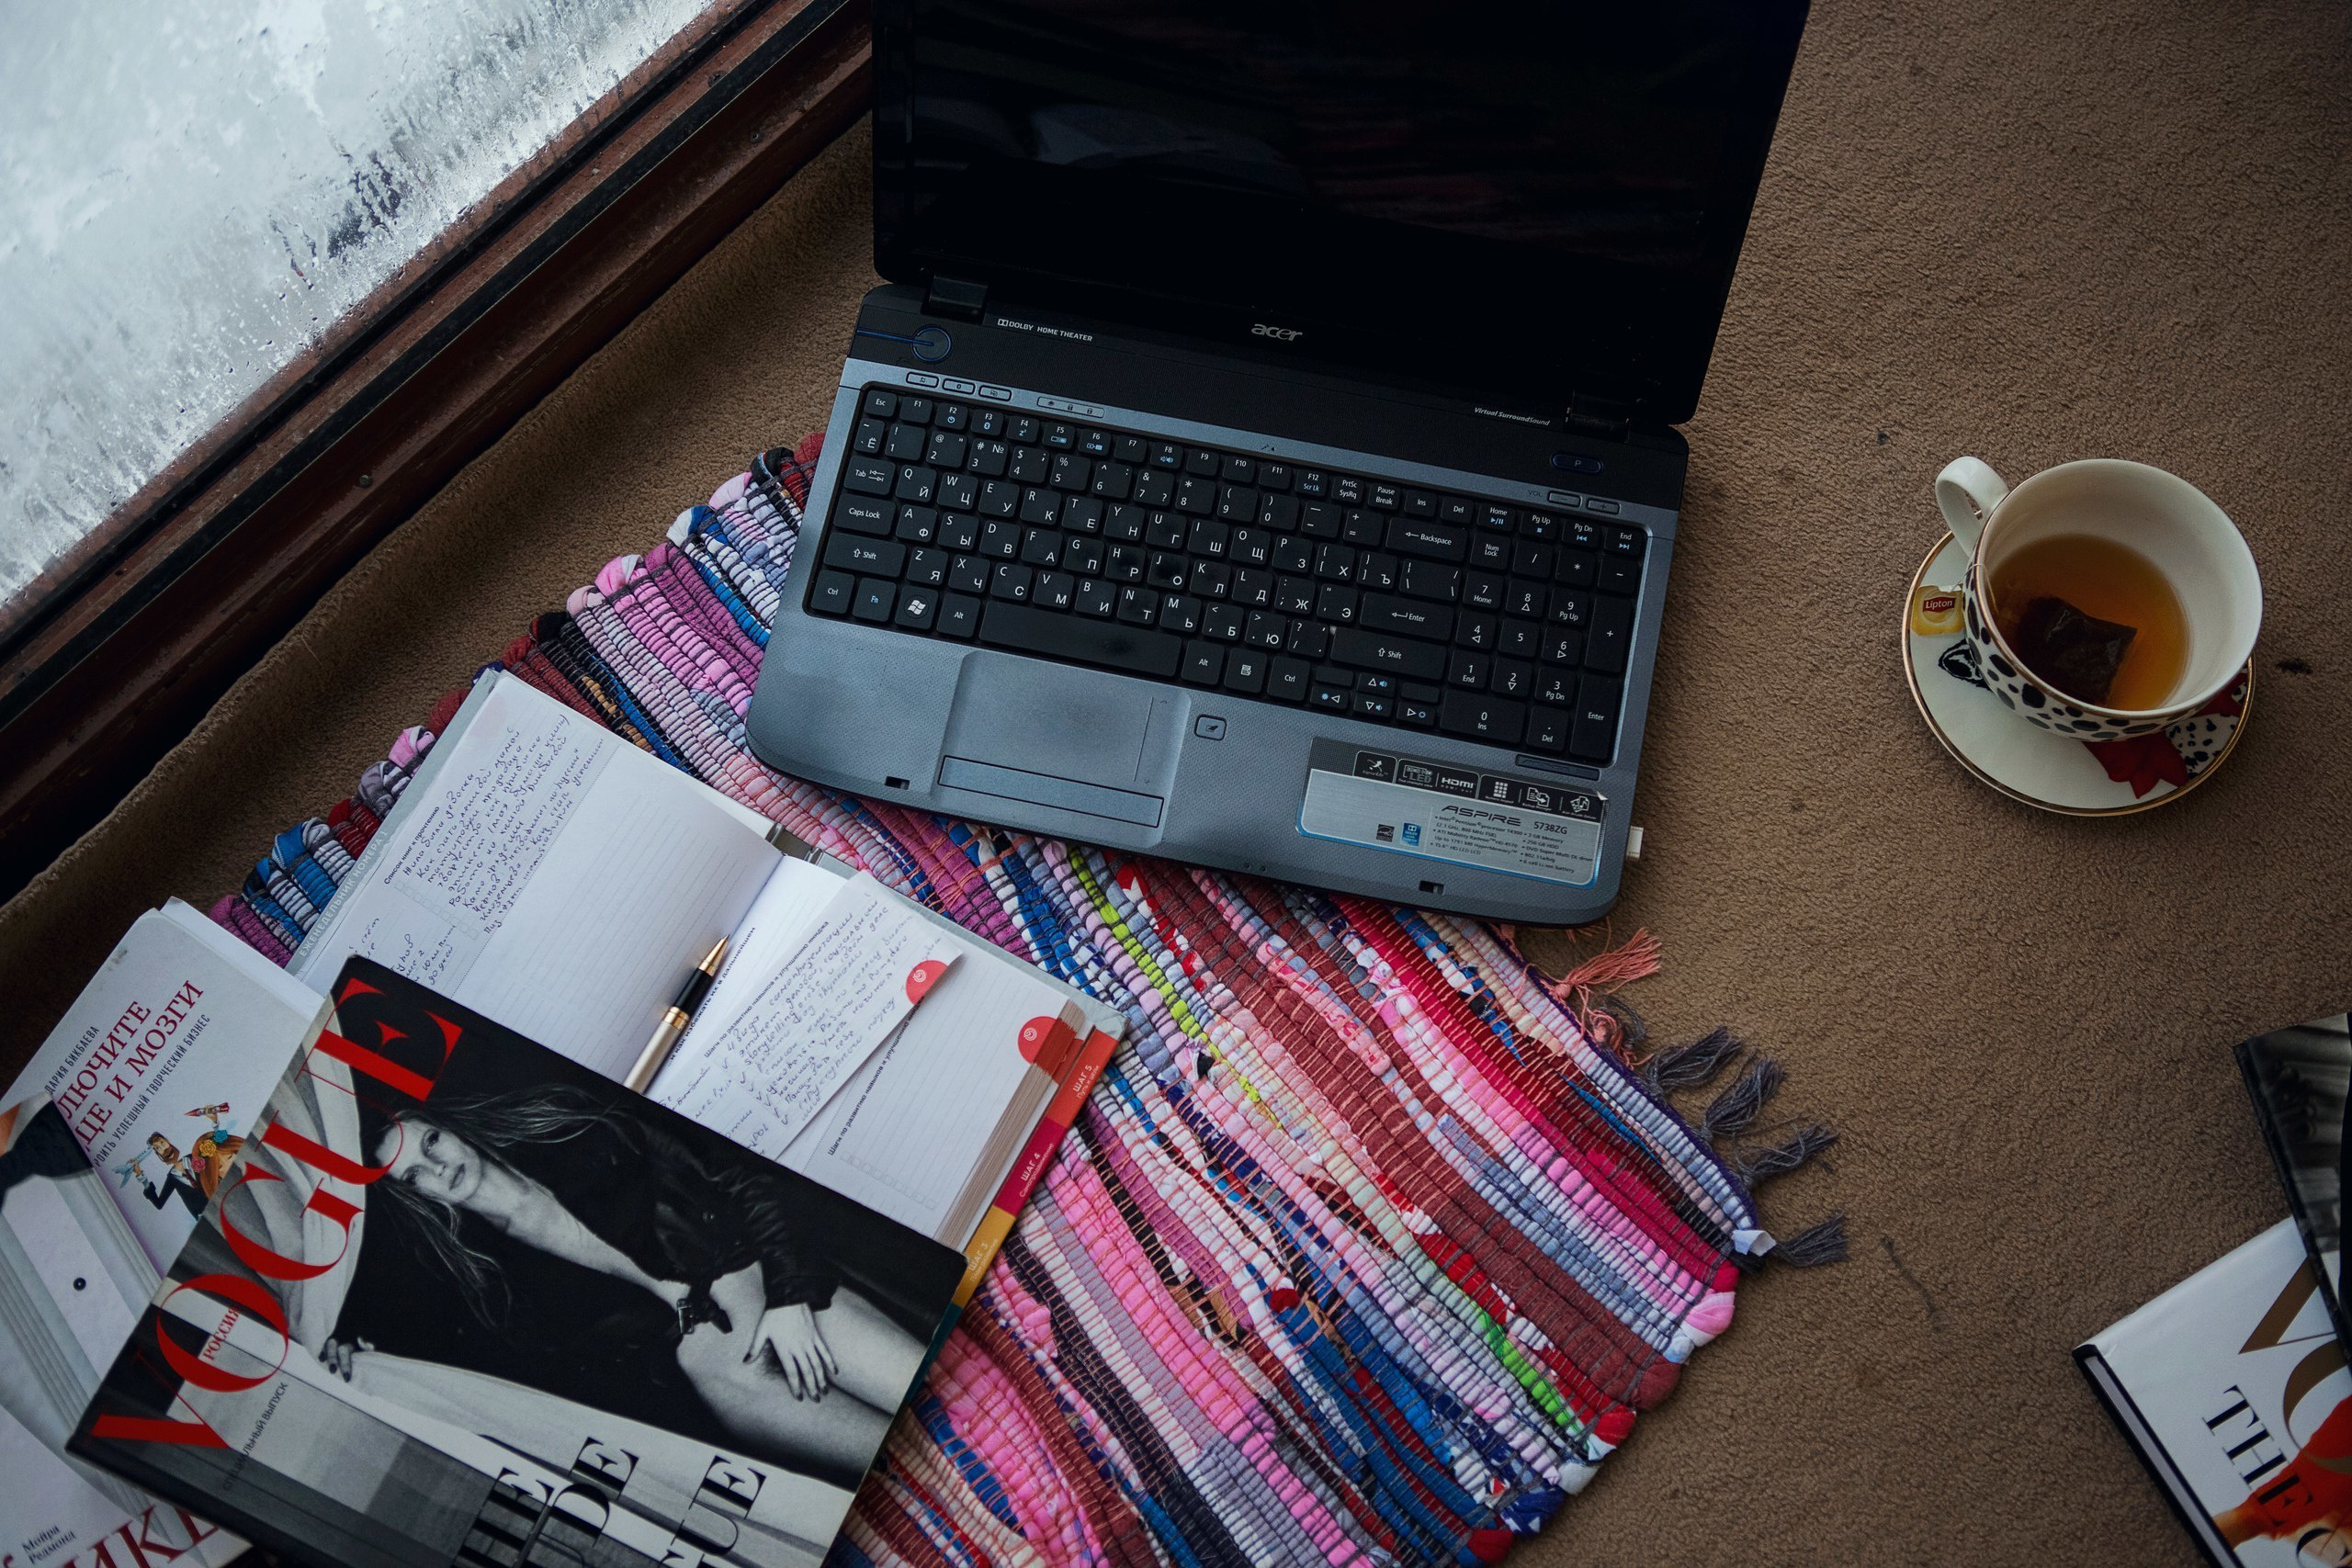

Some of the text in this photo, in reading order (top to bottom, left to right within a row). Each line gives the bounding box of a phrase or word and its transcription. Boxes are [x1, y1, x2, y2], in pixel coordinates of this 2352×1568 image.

[1009, 321, 1092, 342] DOLBY HOME THEATER
[1251, 323, 1303, 341] acer
[876, 398, 886, 406] Esc
[1475, 407, 1550, 425] Virtual SurroundSound
[890, 444, 895, 452] 1
[931, 451, 937, 459] 2
[972, 458, 978, 467] 3
[904, 468, 912, 479] Q
[1013, 467, 1020, 475] 4
[1272, 466, 1283, 474] F11
[1055, 473, 1061, 482] 5
[1307, 473, 1319, 481] F12
[1097, 481, 1102, 490] 6
[1342, 479, 1357, 488] PrtSc
[1139, 489, 1146, 498] 7
[1340, 490, 1357, 500] SysRq
[1376, 486, 1395, 497] Pause
[1181, 497, 1187, 505] 8
[1375, 496, 1393, 505] Break
[849, 507, 880, 519] Caps Lock
[1223, 504, 1229, 513] 9
[1489, 507, 1508, 515] Home
[1532, 514, 1551, 525] Pg Up
[1574, 523, 1583, 532] Pg
[1420, 534, 1452, 545] Backspace
[1620, 532, 1632, 540] End
[863, 551, 876, 559] Shift
[871, 595, 878, 604] Fn
[1474, 595, 1492, 604] Home
[1925, 599, 1953, 610] Lipton
[1408, 613, 1425, 622] Enter
[1559, 611, 1578, 621] Pg Up
[1387, 650, 1402, 660] Shift
[1284, 674, 1295, 682] Ctrl
[1463, 674, 1475, 682] End
[1545, 691, 1555, 700] Pg
[1588, 712, 1604, 720] Enter
[1542, 734, 1554, 742] Del
[1442, 777, 1474, 788] HDMI
[1441, 805, 1521, 827] ASPIRE
[1533, 821, 1567, 835] 5738ZG
[384, 861, 403, 885] Список
[401, 846, 413, 861] книг
[414, 807, 439, 840] прочтению
[300, 878, 356, 957] ЕЖЕНЕДЕЛЬНИК
[354, 839, 386, 881] НОМЕРА
[675, 1037, 686, 1055] как
[685, 998, 711, 1038] избежать
[722, 927, 756, 979] дальнейшем
[704, 1042, 720, 1057] Шаги
[719, 1033, 728, 1042] по
[727, 1006, 752, 1034] развитию
[752, 981, 775, 1006] навыков
[778, 943, 808, 977] улучшению
[808, 921, 829, 943] имиджа
[44, 1026, 100, 1095] ДАРИЯ БИКБАЕВА
[74, 980, 204, 1152] ЦЕ И МОЗГИ
[113, 1095, 150, 1140] УСПЕШНЫЙ
[146, 1045, 187, 1096] ТВОРЧЕСКИЙ
[184, 1014, 210, 1046] БИЗНЕС
[1072, 1072, 1087, 1092] ШАГ
[828, 1137, 842, 1156] Шаги
[840, 1127, 848, 1136] по
[845, 1095, 866, 1127] развитию
[865, 1066, 884, 1094] навыков
[885, 1020, 910, 1060] улучшению
[1019, 1143, 1054, 1197] Самопродвижение
[1021, 1160, 1035, 1181] ШАГ
[91, 977, 462, 1449] VOGUE
[202, 1304, 240, 1362] РОССИЯ
[222, 1382, 289, 1492] СПЕЦИАЛЬНЫЙ ВЫПУСК
[2202, 1384, 2316, 1528] THE
[21, 1525, 61, 1552] Мойра
[28, 1531, 77, 1565] Редмонд
